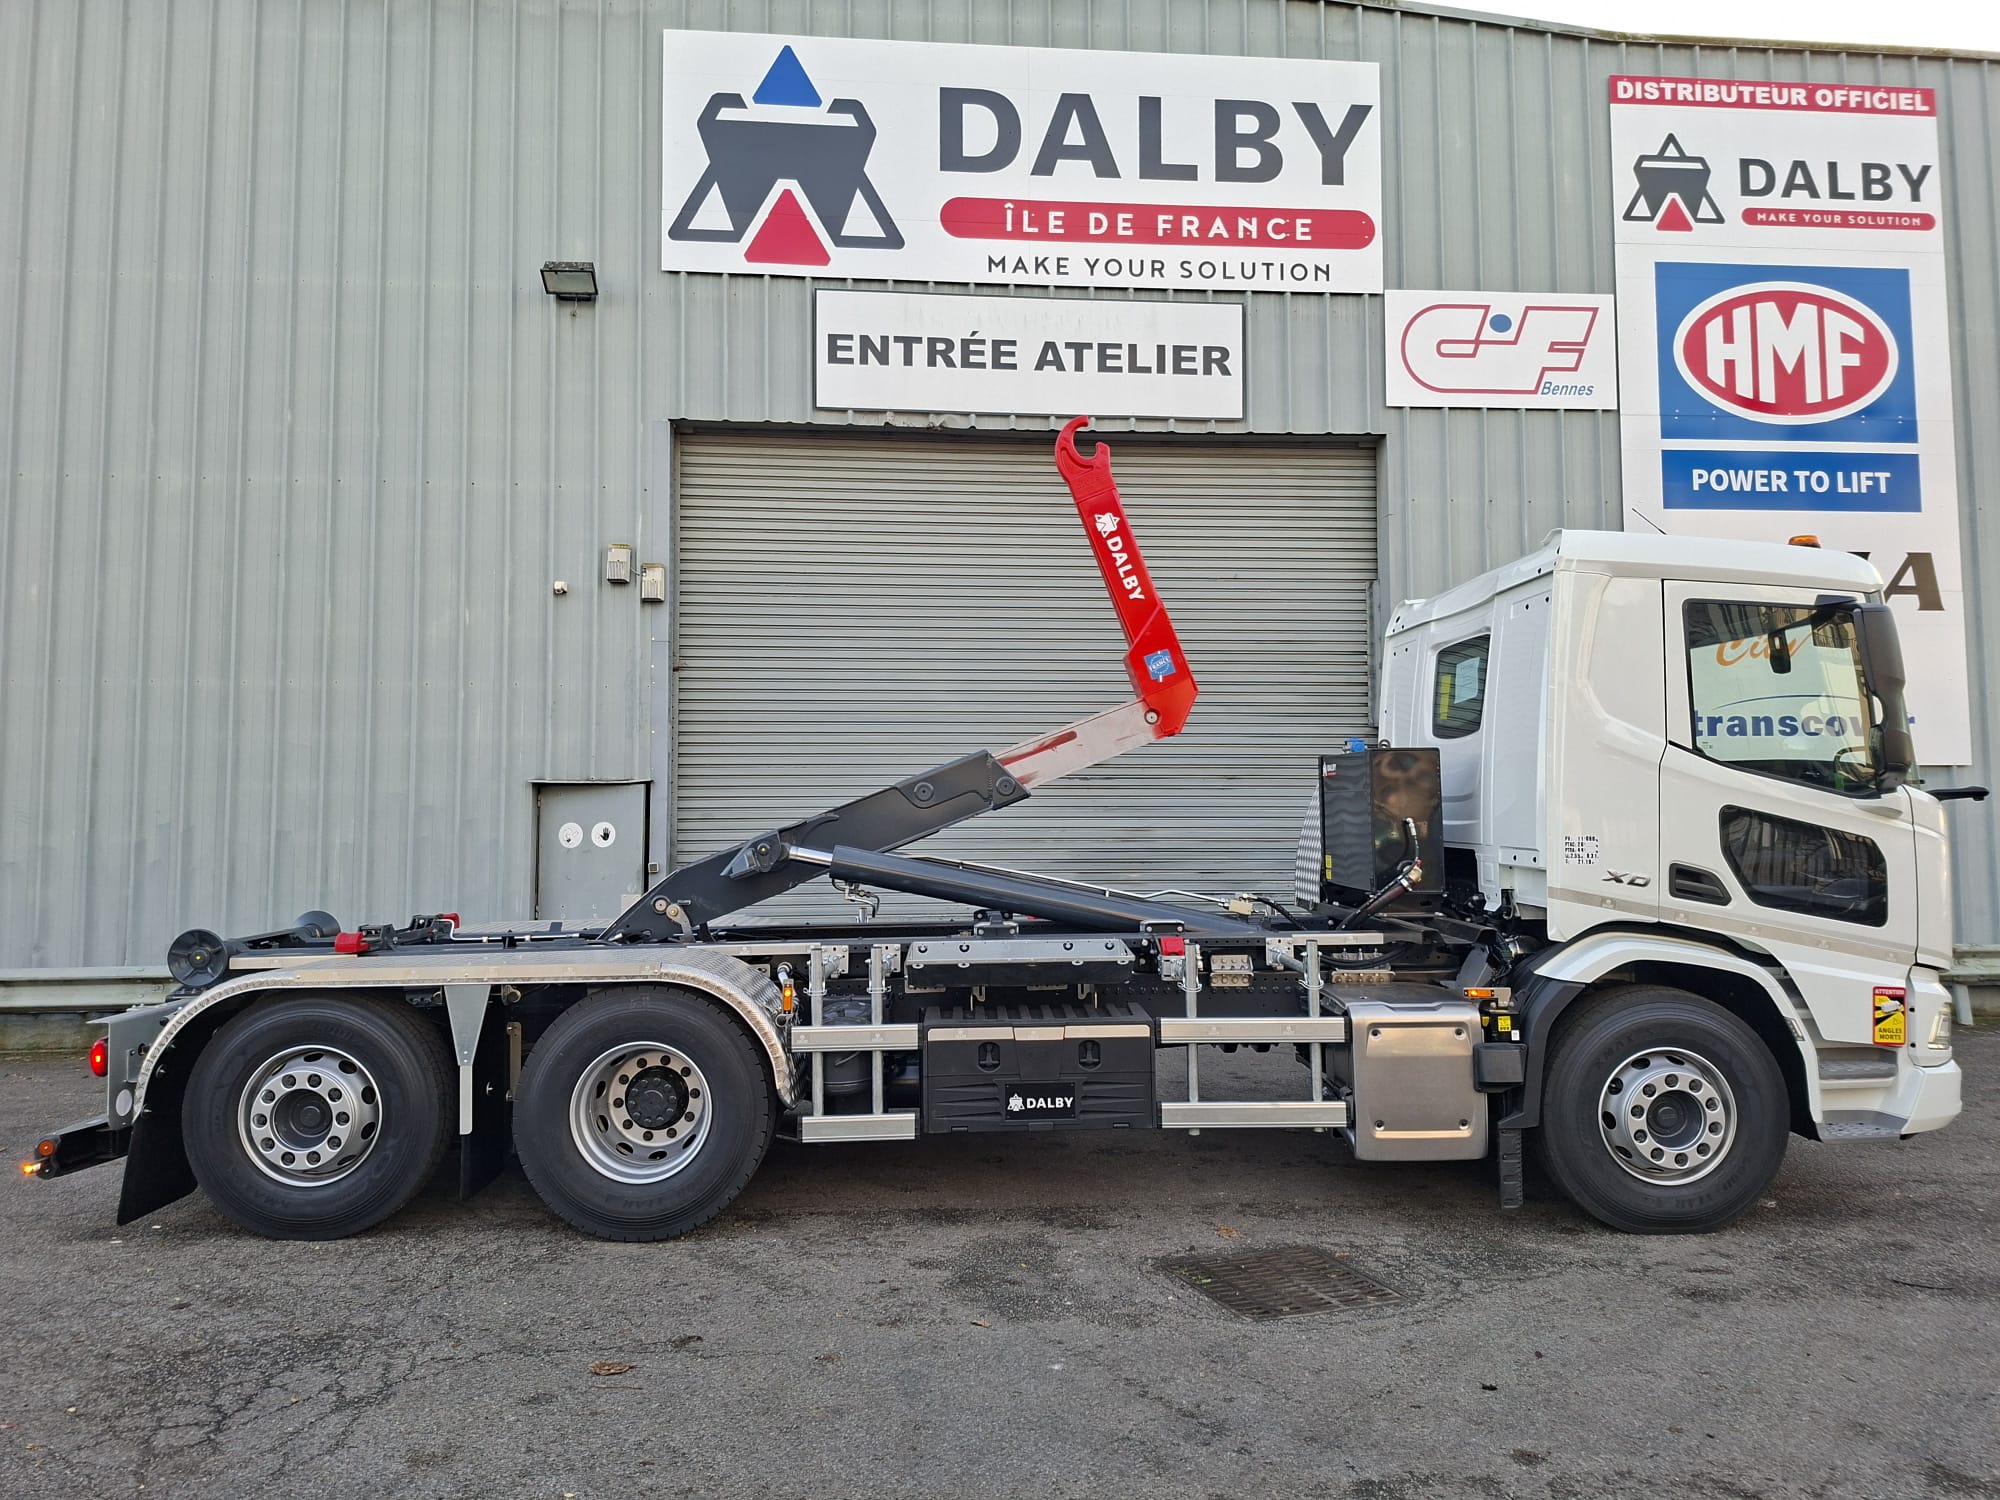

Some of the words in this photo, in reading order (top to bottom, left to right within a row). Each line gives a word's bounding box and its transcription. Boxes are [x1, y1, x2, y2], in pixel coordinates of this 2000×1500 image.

[1616, 80, 1809, 107] DISTRIBUTEUR
[1814, 88, 1931, 112] OFFICIEL
[939, 86, 1374, 187] DALBY
[1738, 157, 1933, 203] DALBY
[1005, 203, 1066, 235] ÎLE
[1088, 212, 1135, 237] DE
[1157, 214, 1314, 242] FRANCE
[1756, 212, 1798, 223] MAKE
[1802, 213, 1843, 225] YOUR
[1847, 215, 1922, 227] SOLUTION
[988, 255, 1070, 277] MAKE
[1084, 257, 1166, 279] YOUR
[1179, 260, 1331, 283] SOLUTION
[827, 331, 1018, 372] ENTRÉE
[1033, 341, 1232, 377] ATELIER
[1705, 301, 1866, 405] HMF
[1541, 381, 1595, 396] Bennes
[1692, 469, 1789, 493] POWER
[1793, 470, 1830, 494] TO
[1837, 471, 1891, 495] LIFT
[1106, 536, 1146, 600] DALBY
[1694, 709, 1916, 738] transcov
[1026, 1097, 1074, 1110] DALBY
